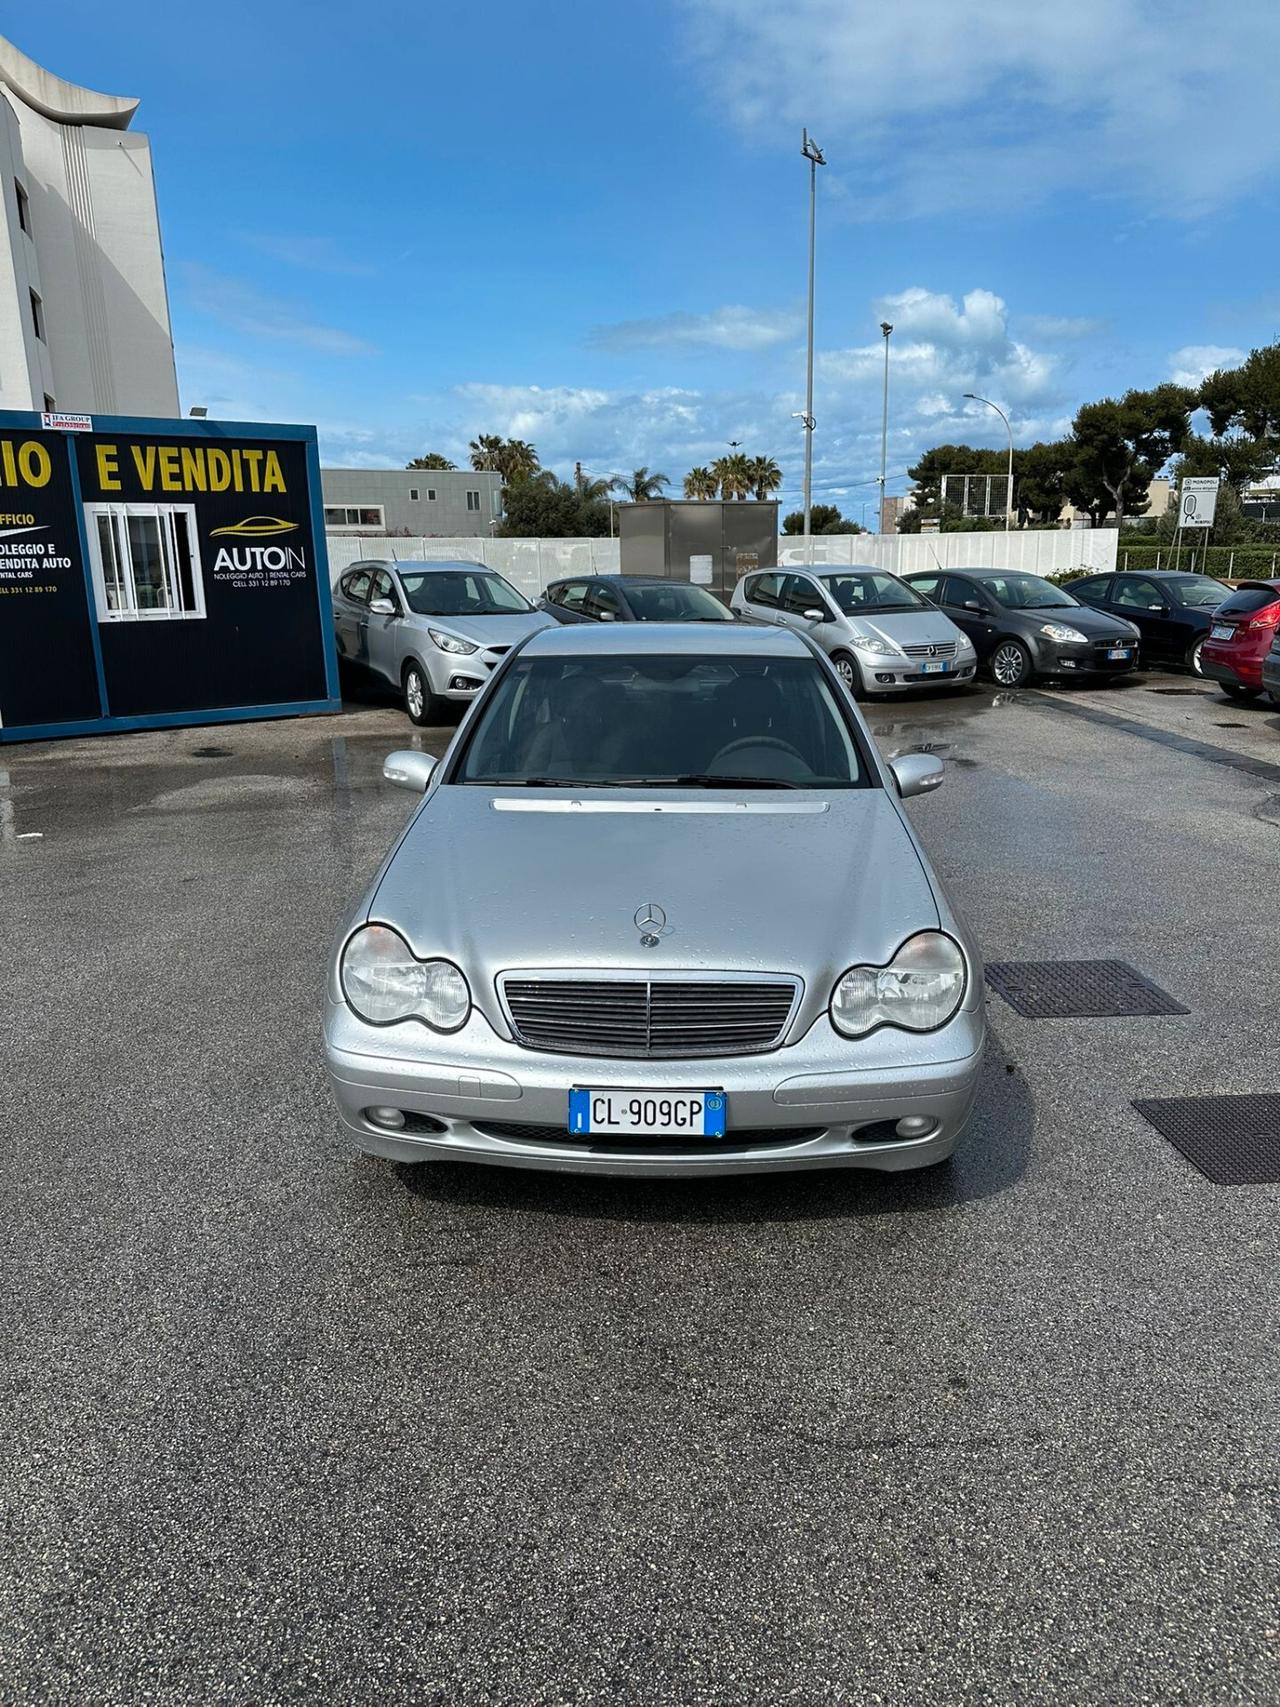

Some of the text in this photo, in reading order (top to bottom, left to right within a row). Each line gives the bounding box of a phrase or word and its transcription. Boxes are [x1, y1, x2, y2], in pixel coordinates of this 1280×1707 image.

[0, 440, 287, 493] IO E VENDITA
[0, 543, 56, 555] OLEGGIO E
[0, 557, 72, 569] ENDITA AUTO
[213, 546, 306, 571] AUTOIN
[17, 571, 33, 579] CARS
[213, 572, 247, 580] NOLEGGIO
[248, 572, 264, 580] AUTO
[269, 571, 290, 579] RENTAL
[233, 579, 291, 588] CELL 331 12 89 170
[10, 586, 23, 594] 331
[45, 585, 58, 593] 170
